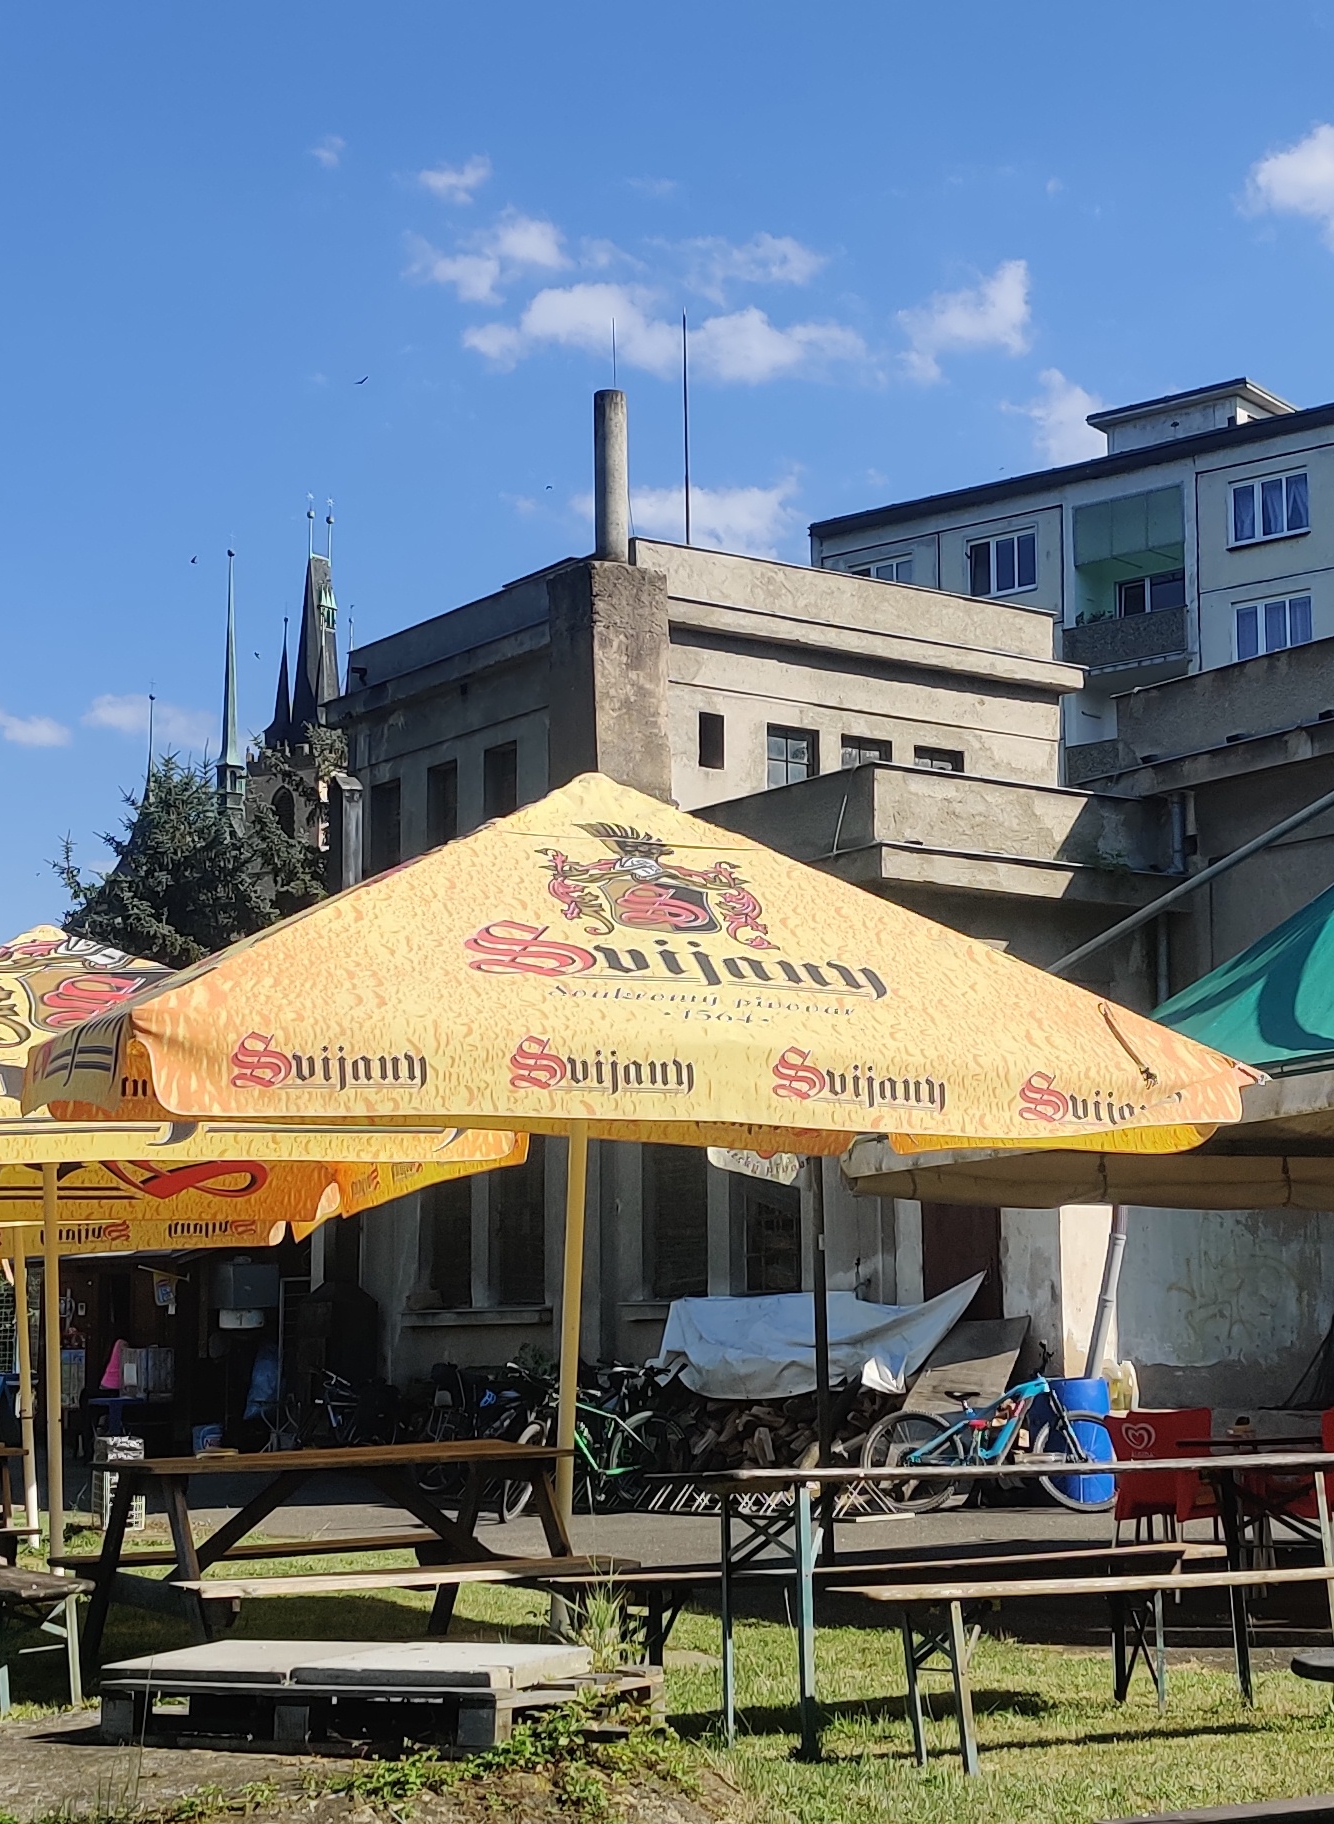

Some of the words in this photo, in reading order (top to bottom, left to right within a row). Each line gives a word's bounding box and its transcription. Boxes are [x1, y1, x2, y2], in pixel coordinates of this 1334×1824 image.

[465, 919, 888, 1001] Svijany
[230, 1031, 427, 1092] Svijany
[509, 1035, 695, 1095] Svijany
[772, 1045, 946, 1114] Svijany
